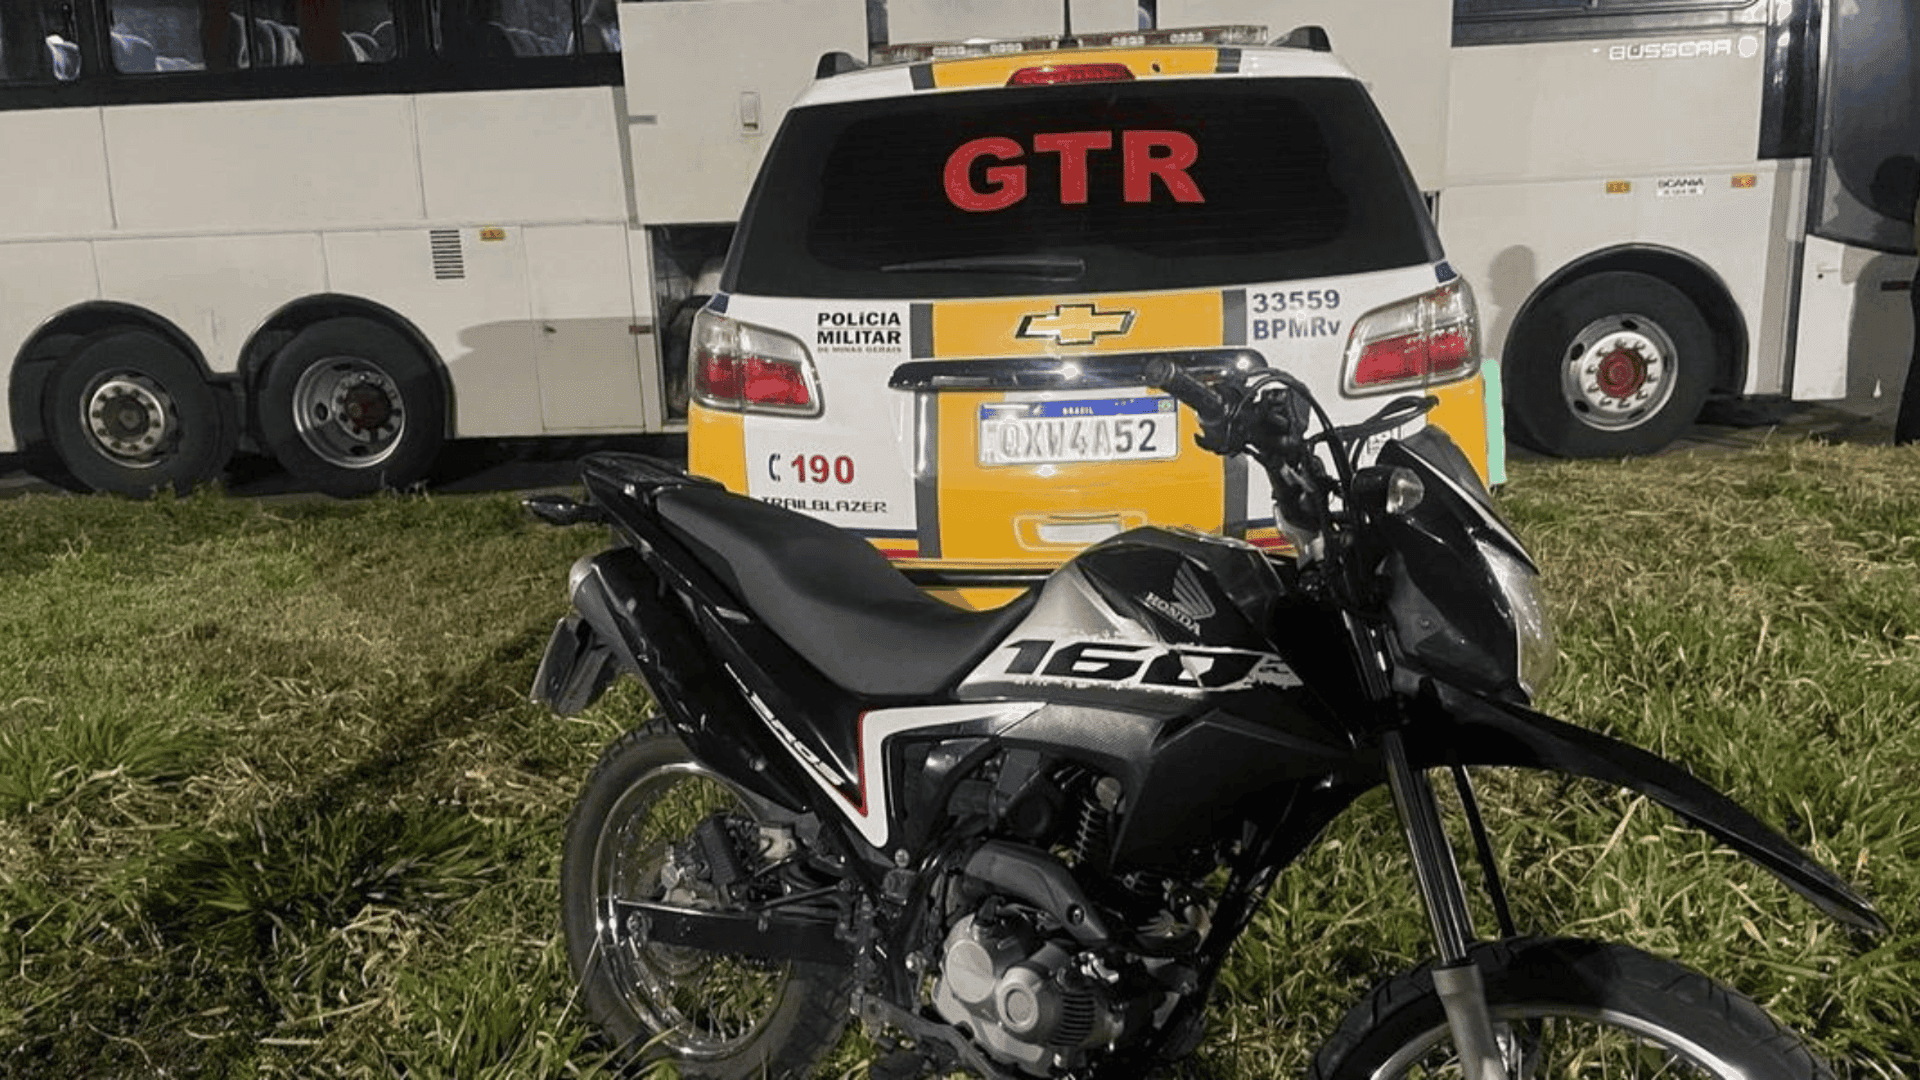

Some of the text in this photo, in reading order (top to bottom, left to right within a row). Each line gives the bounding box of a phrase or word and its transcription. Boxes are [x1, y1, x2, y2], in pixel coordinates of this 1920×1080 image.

[1609, 39, 1731, 60] BUSSCAR
[944, 130, 1205, 212] GTR
[1253, 289, 1340, 313] 33559
[817, 330, 901, 345] MILITAR
[1253, 316, 1341, 340] BPMRv
[791, 454, 854, 484] 190
[1144, 591, 1200, 637] HONDA
[1004, 638, 1264, 688] 160
